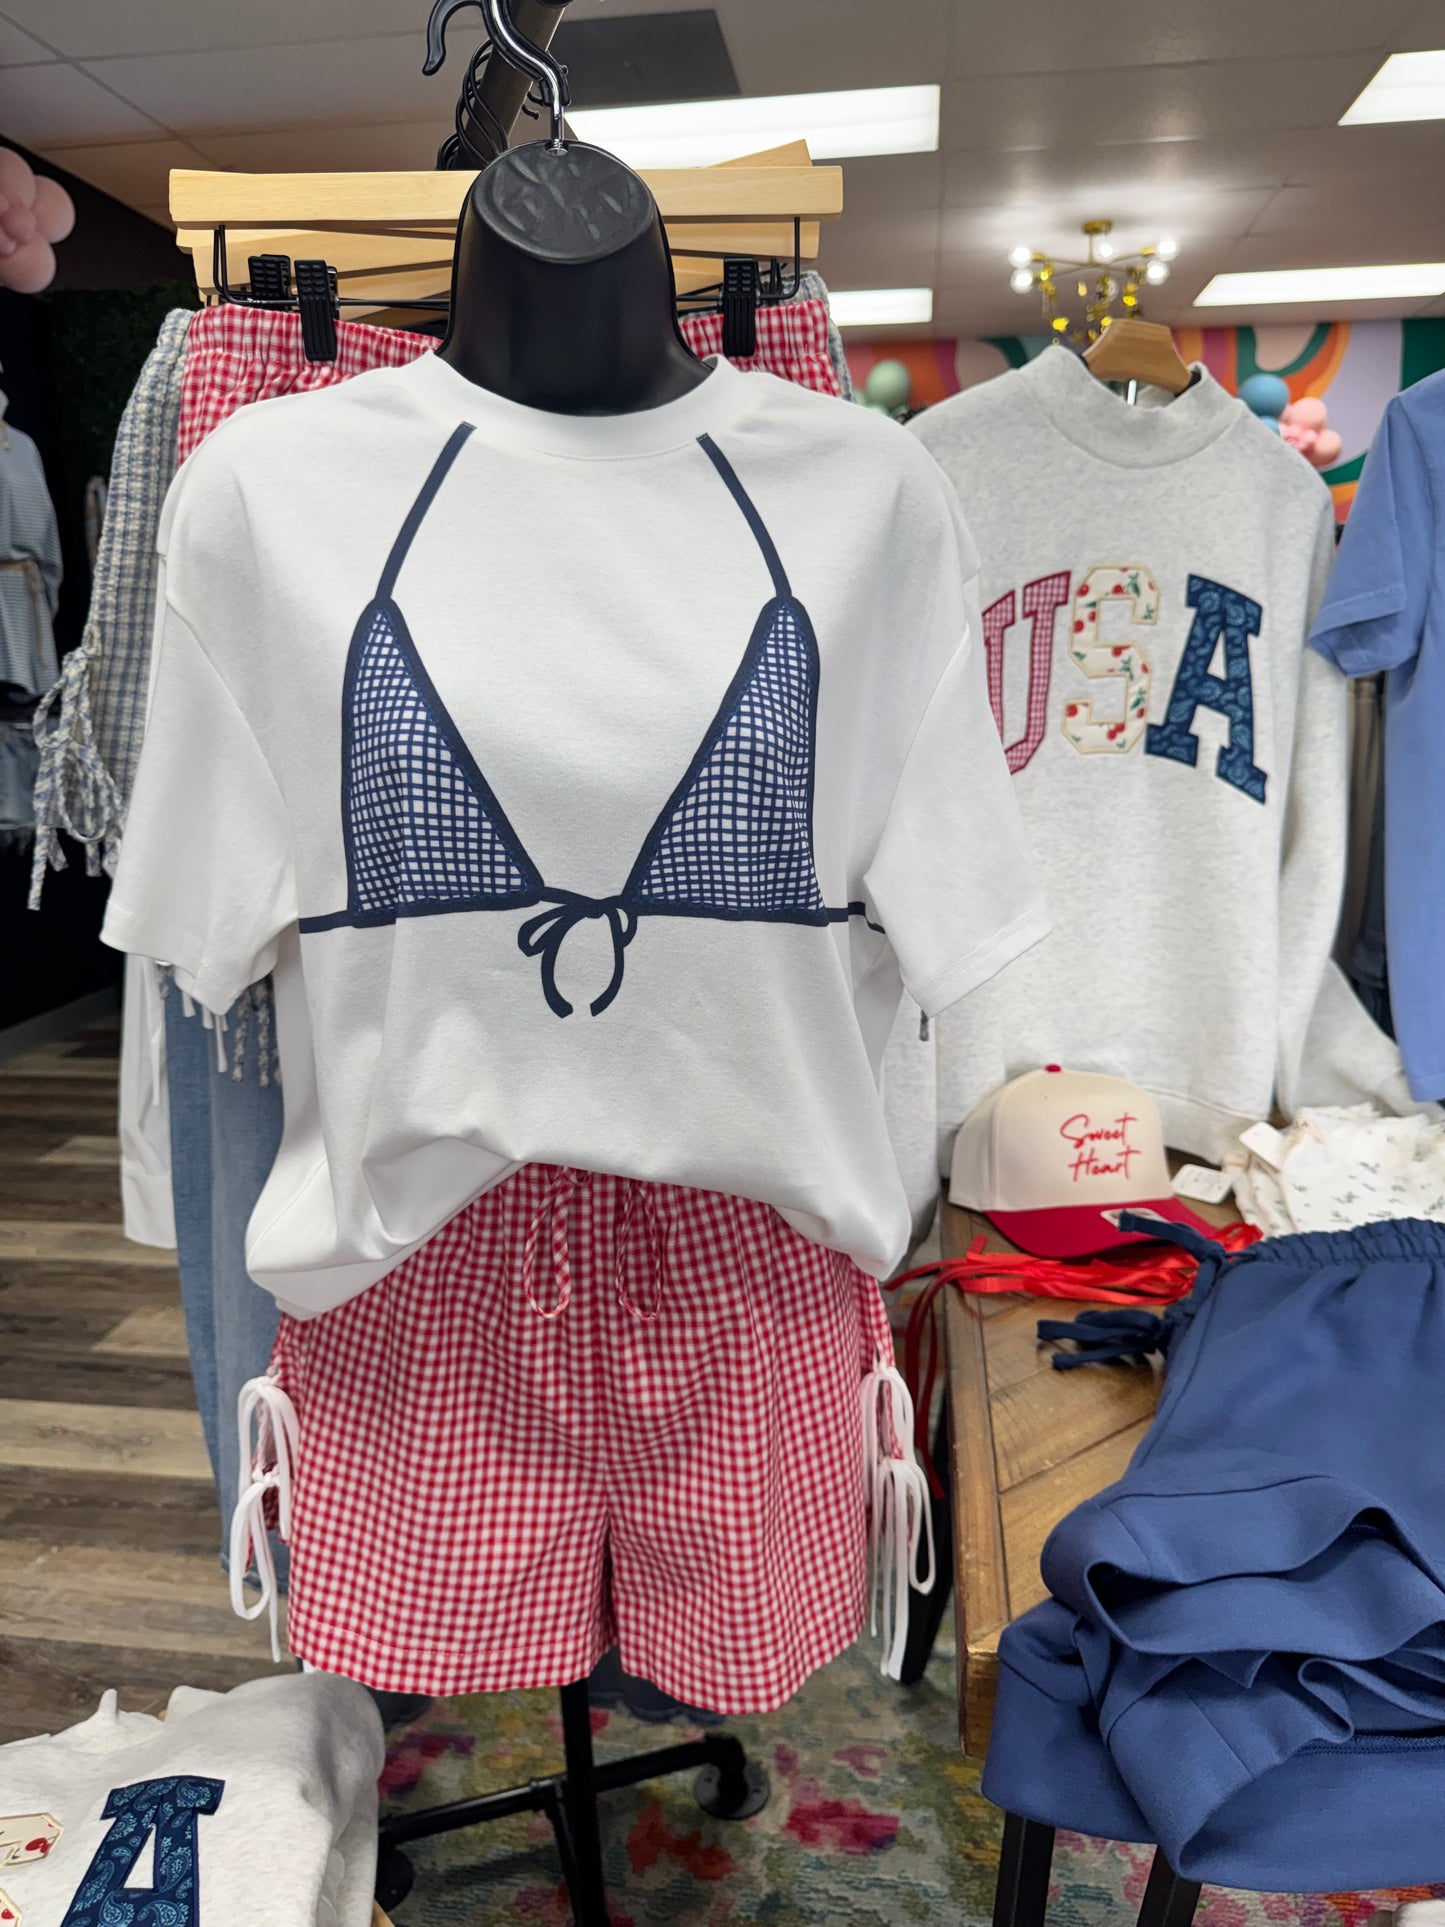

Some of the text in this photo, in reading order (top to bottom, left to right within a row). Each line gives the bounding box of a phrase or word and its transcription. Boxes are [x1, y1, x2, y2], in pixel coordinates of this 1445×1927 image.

[981, 562, 1267, 805] USA
[1059, 1112, 1138, 1149] Sweet
[1067, 1145, 1143, 1182] Heart
[0, 1775, 226, 1927] A
